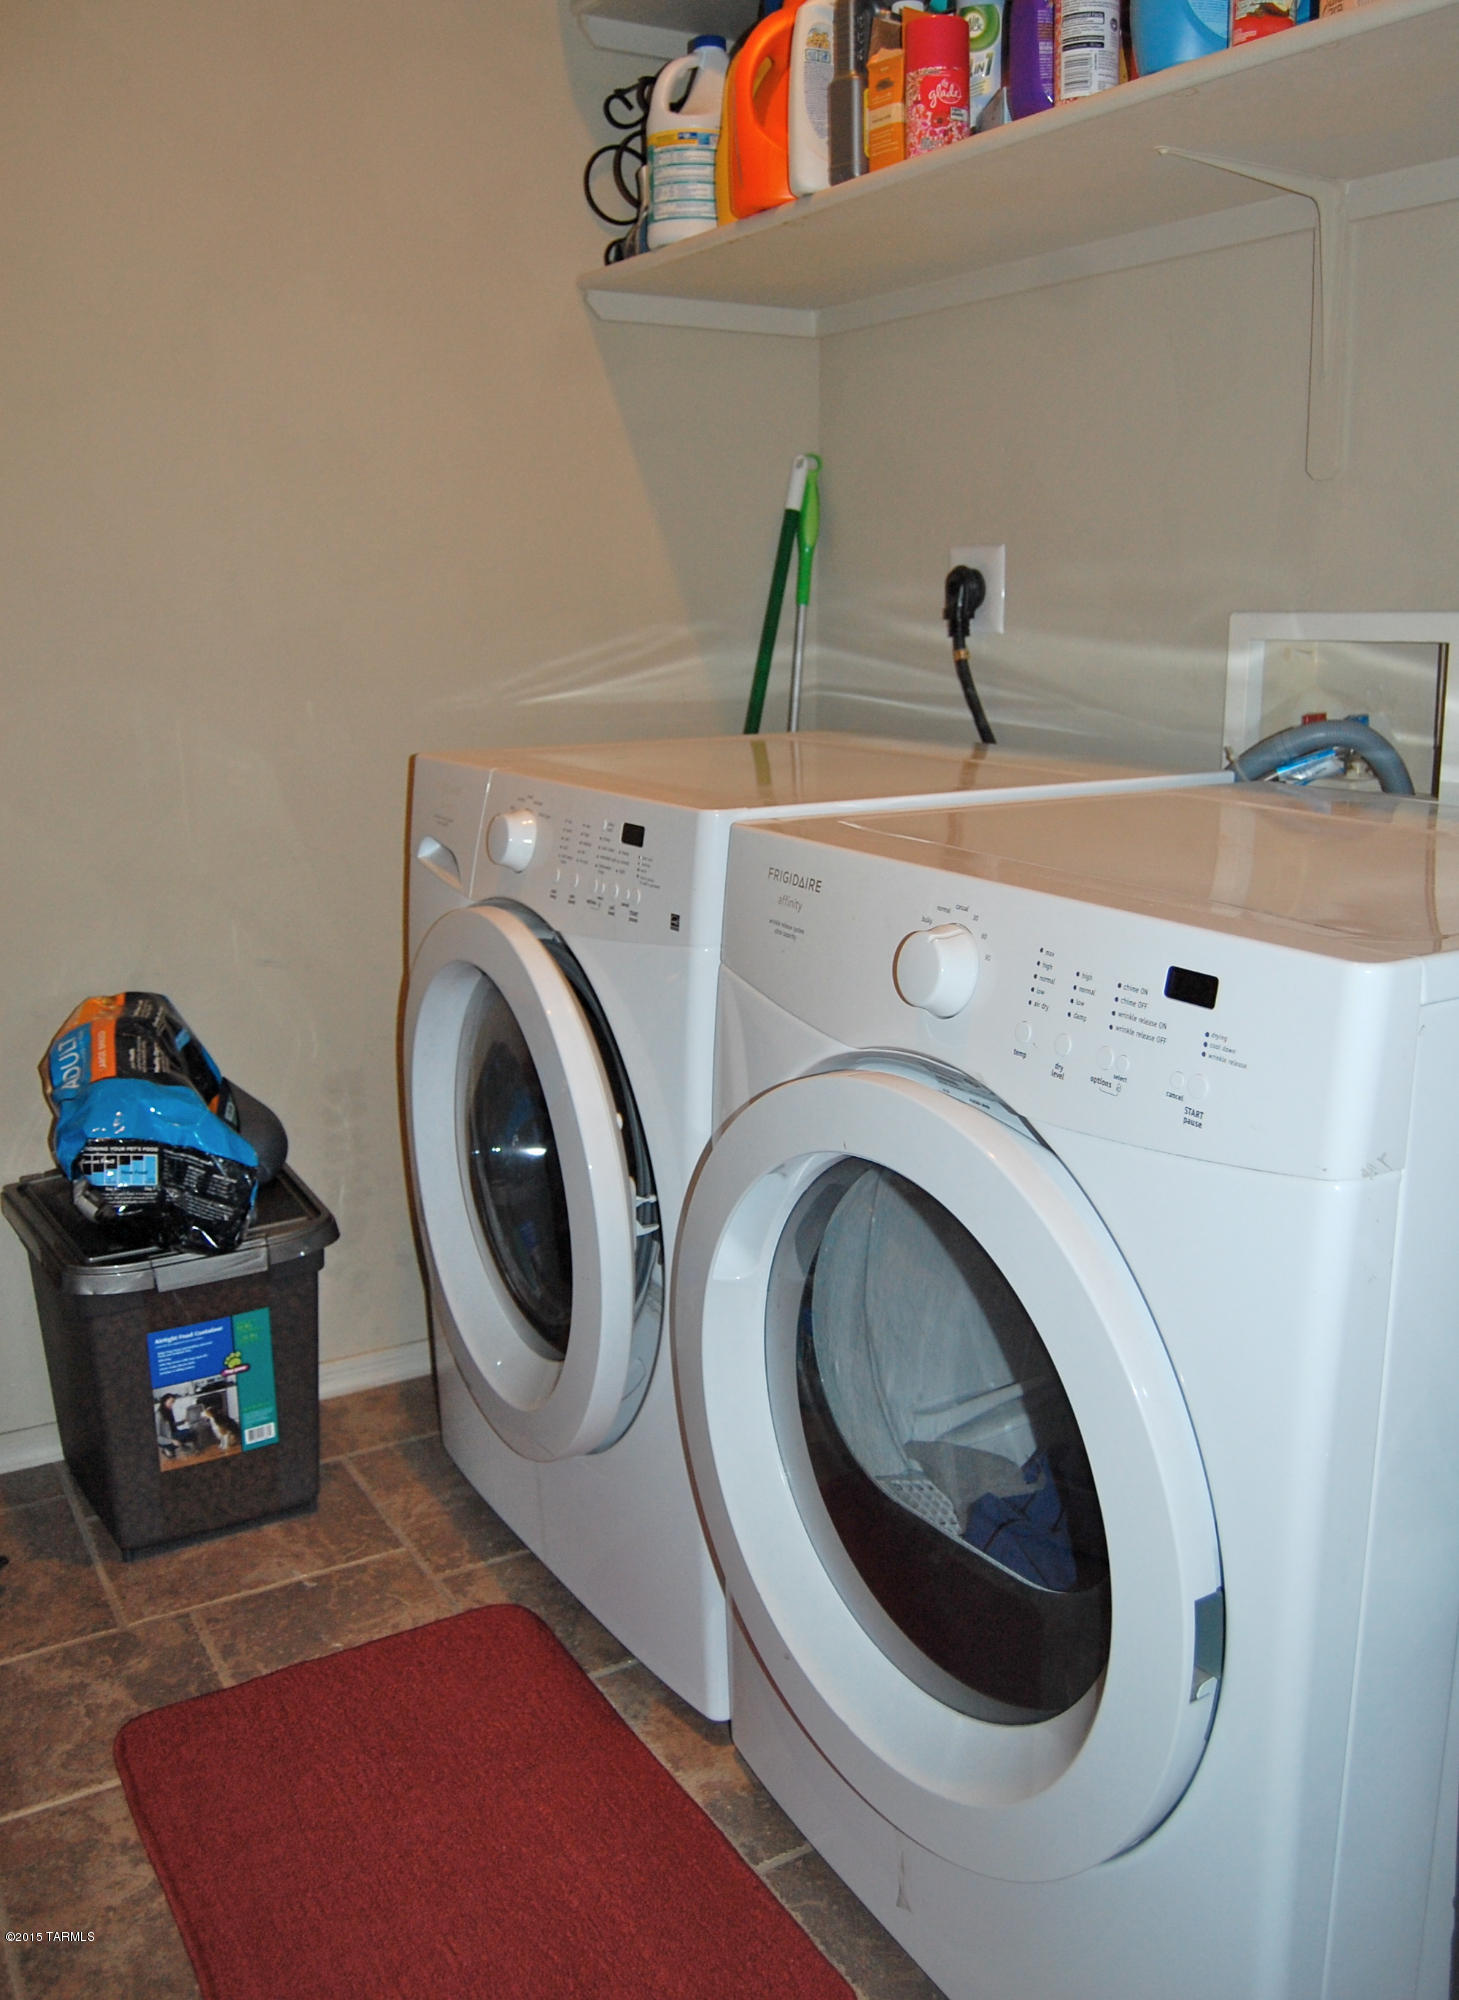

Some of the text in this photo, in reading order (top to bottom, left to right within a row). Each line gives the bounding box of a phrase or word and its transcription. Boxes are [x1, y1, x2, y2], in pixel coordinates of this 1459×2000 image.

[928, 82, 961, 108] glade
[768, 867, 822, 893] FRIGIDAIRE
[777, 894, 803, 912] affinity
[1140, 987, 1149, 996] ON
[1137, 1001, 1148, 1010] OFF
[1118, 1012, 1167, 1030] wrinkle release ON
[1115, 1026, 1167, 1045] wrinkle release OFF
[1013, 1049, 1027, 1060] temp
[1055, 1063, 1064, 1073] dry
[1051, 1070, 1065, 1081] level
[1090, 1076, 1112, 1089] options
[1165, 1091, 1184, 1102] cancel
[1184, 1106, 1204, 1120] START
[1183, 1117, 1203, 1129] pause
